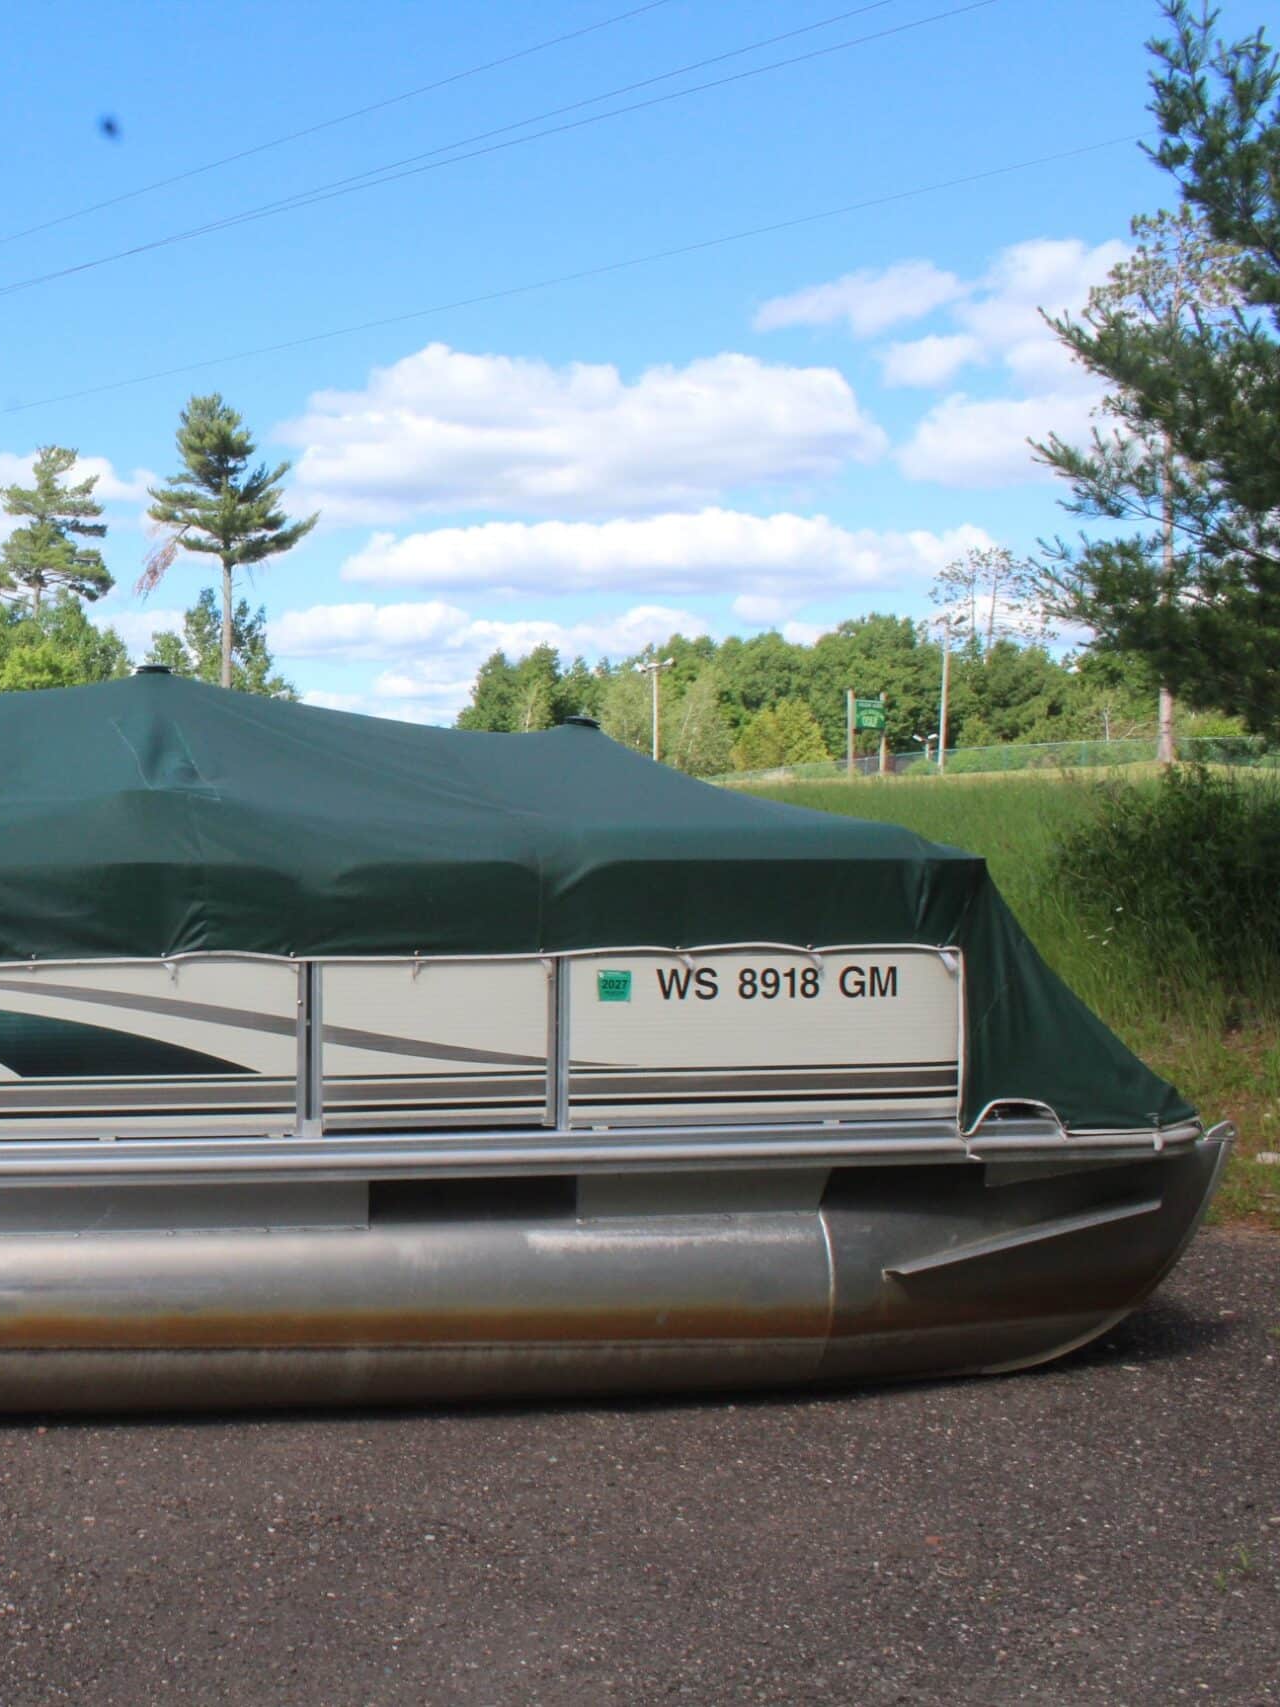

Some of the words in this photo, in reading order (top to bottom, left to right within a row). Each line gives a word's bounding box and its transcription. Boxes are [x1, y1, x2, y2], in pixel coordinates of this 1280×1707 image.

[601, 979, 628, 989] 2027
[657, 968, 719, 1000] WS
[738, 967, 820, 999] 8918
[839, 966, 898, 998] GM
